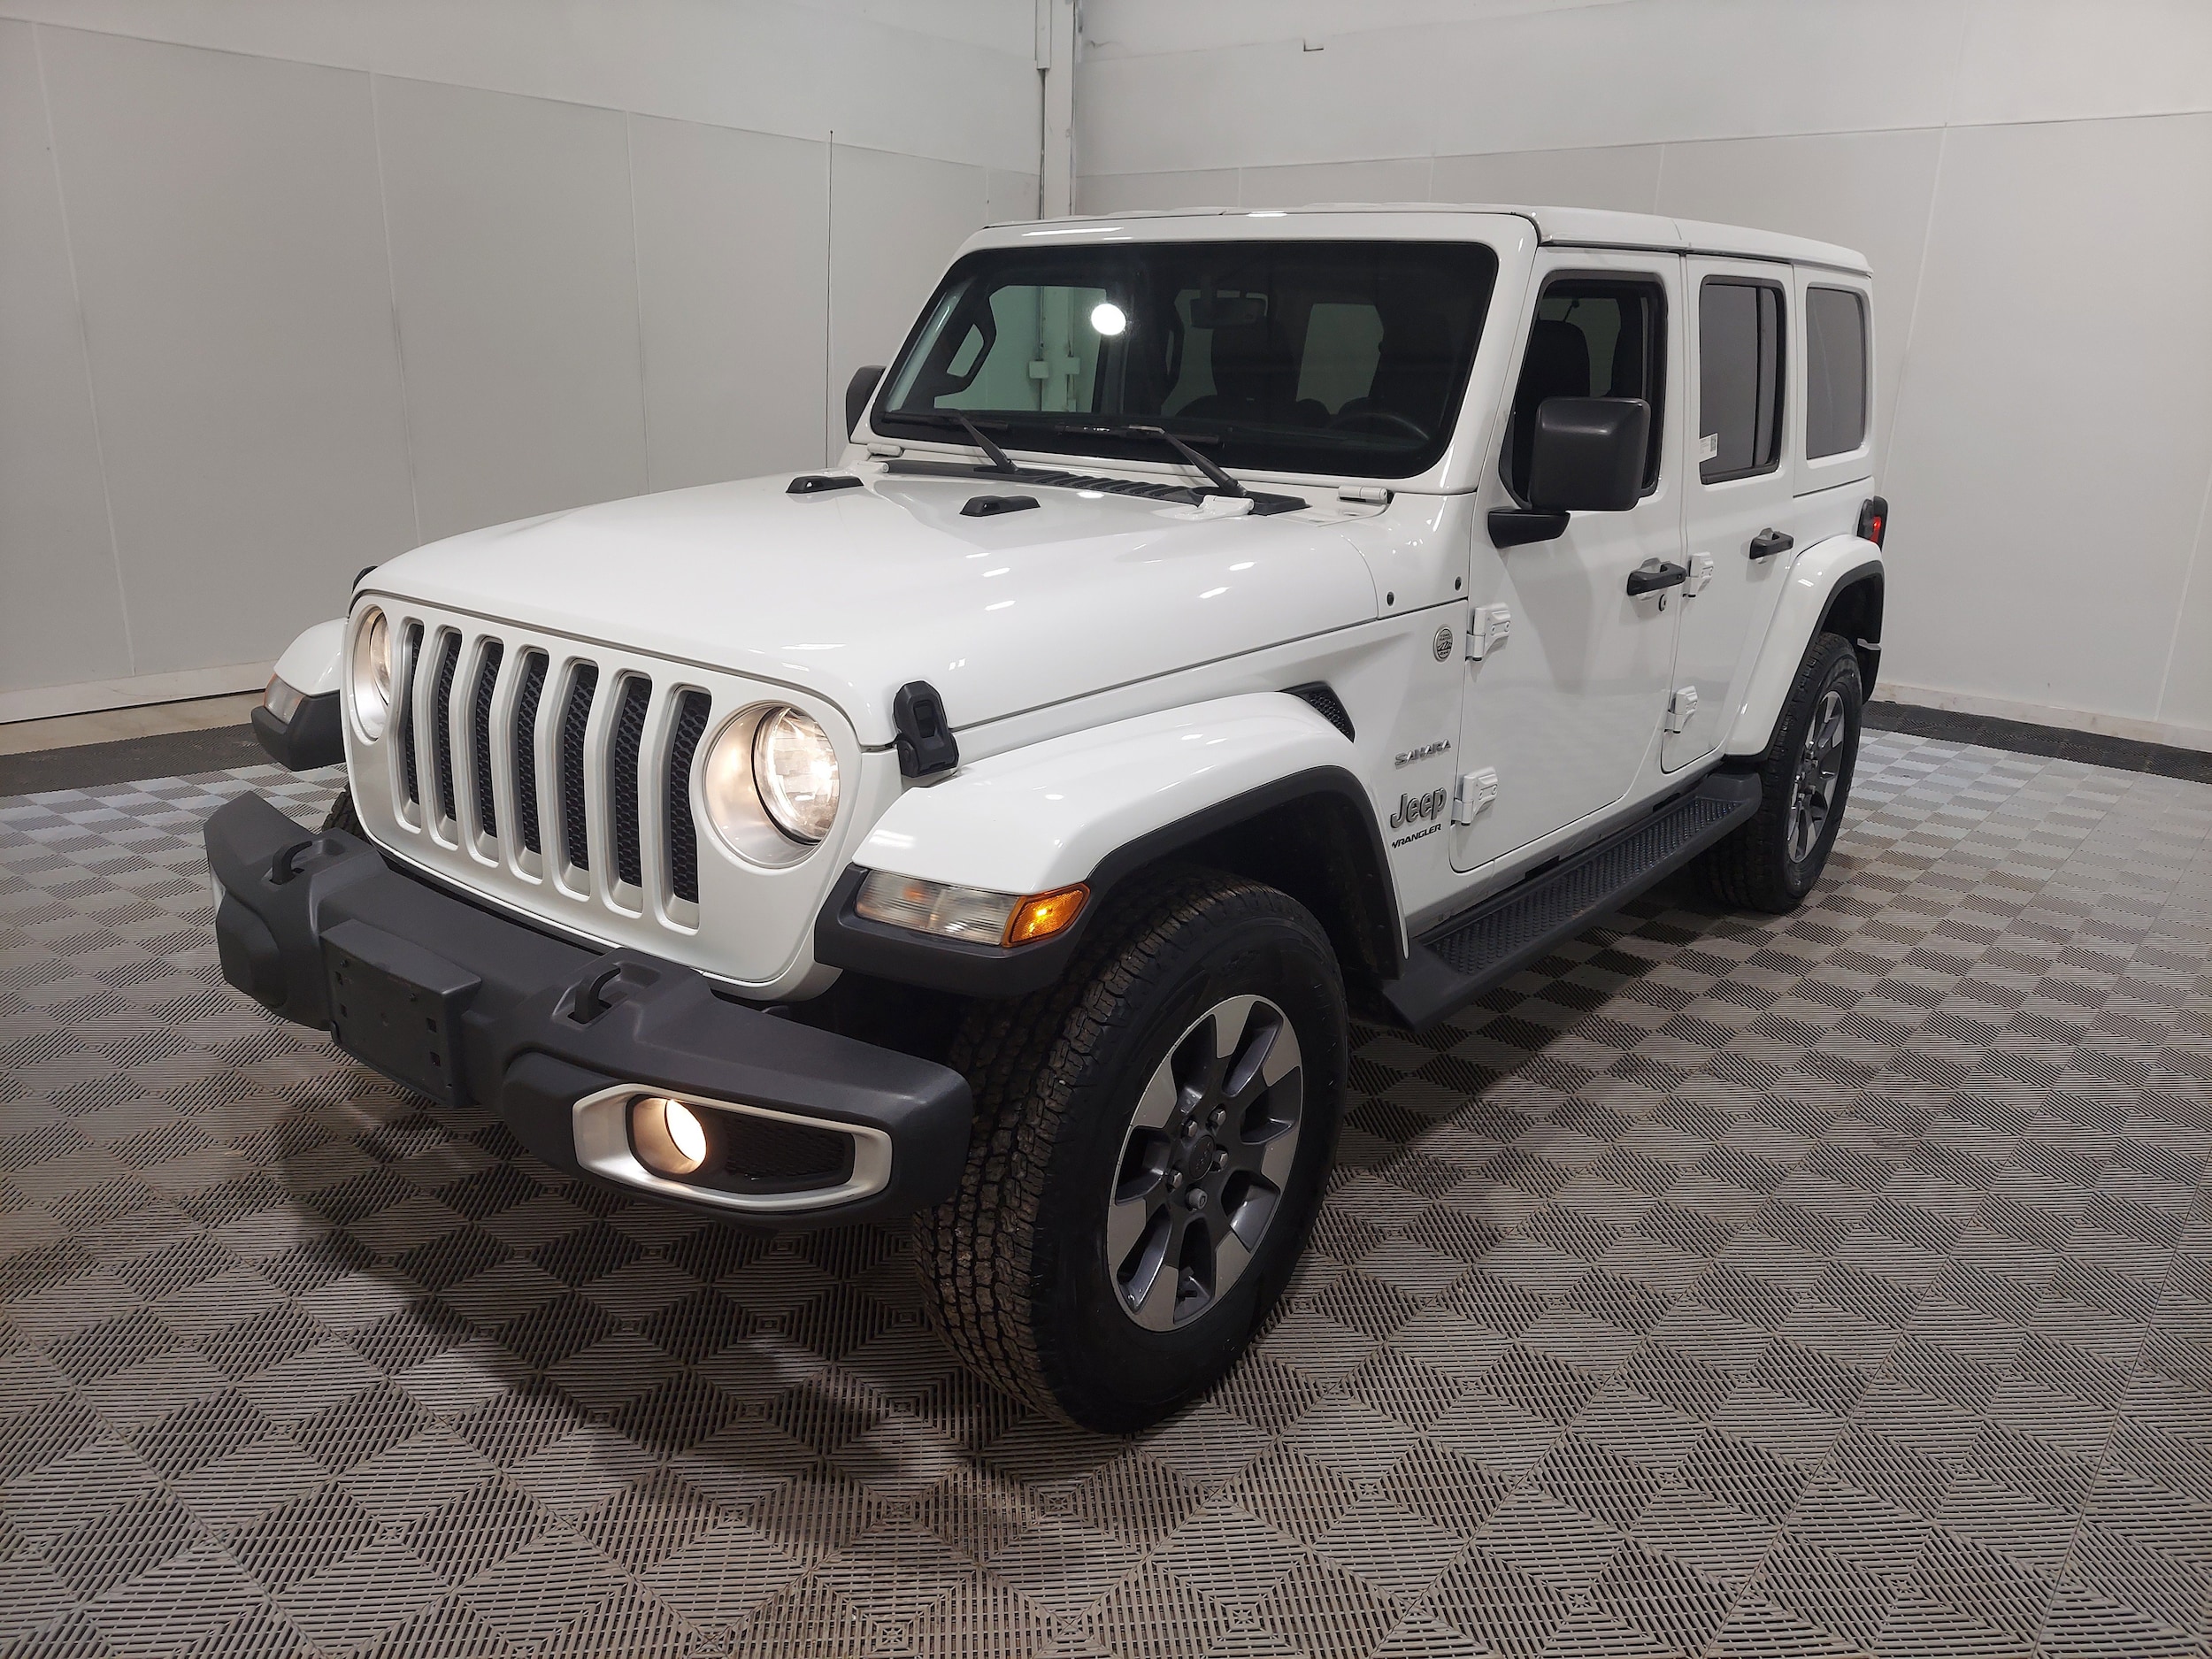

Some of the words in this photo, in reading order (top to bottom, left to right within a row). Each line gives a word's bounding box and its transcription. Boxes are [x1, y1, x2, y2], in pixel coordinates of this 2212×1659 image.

[1394, 739, 1451, 767] SAHARA
[1390, 787, 1448, 828] Jeep
[1392, 824, 1441, 849] WRANGLER
